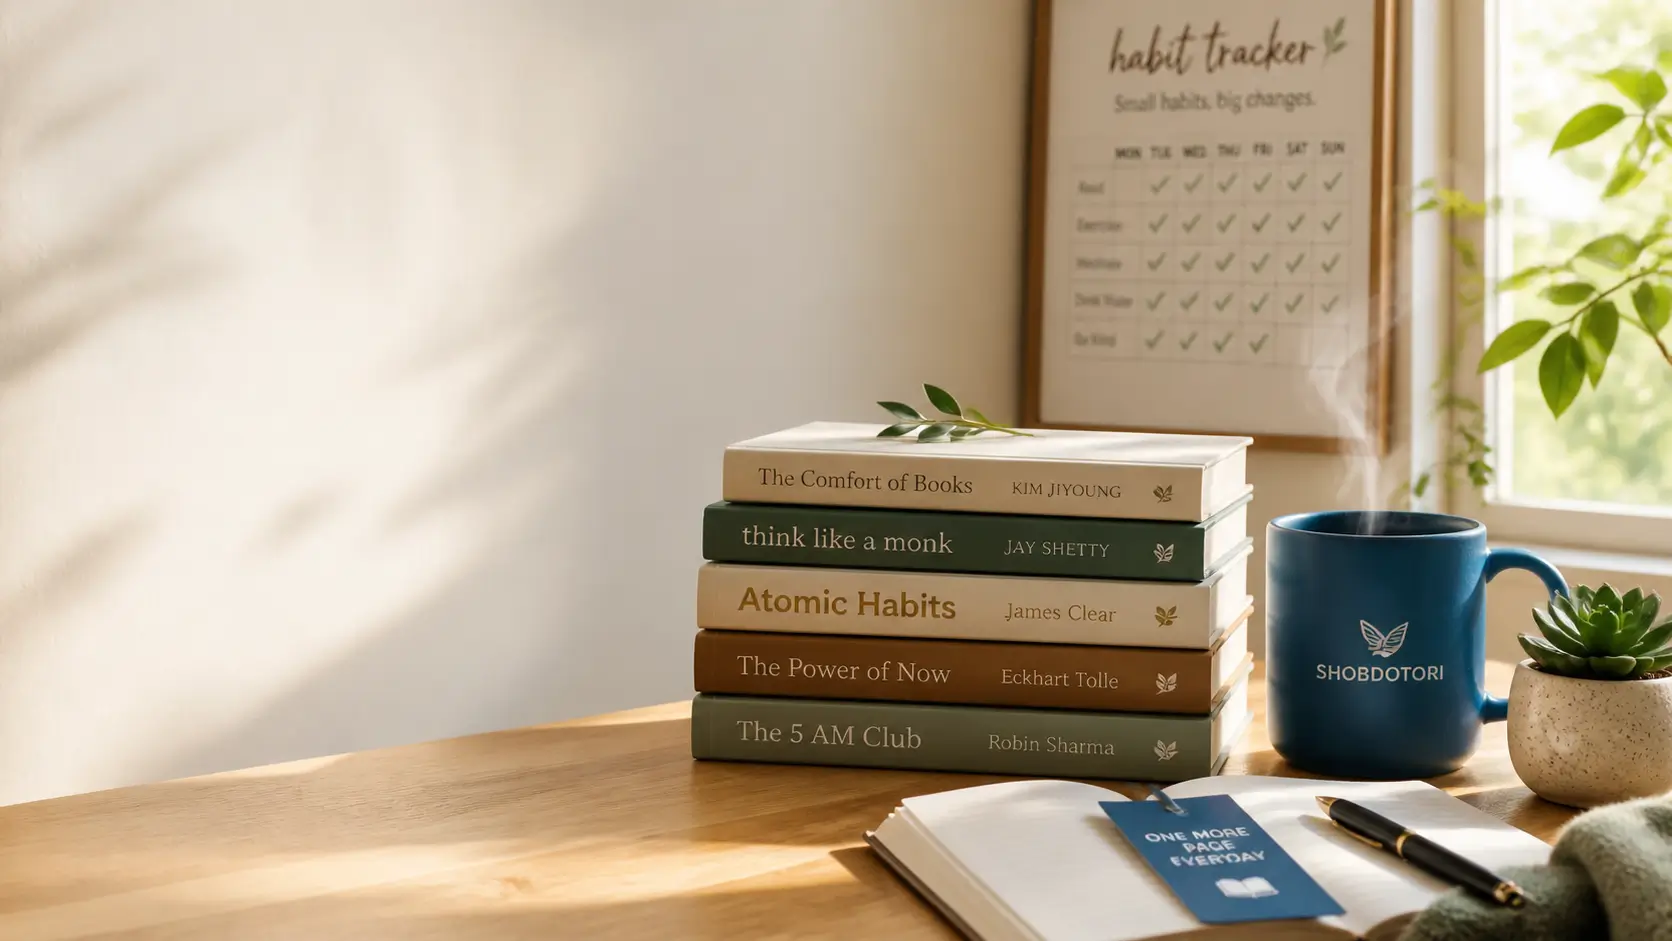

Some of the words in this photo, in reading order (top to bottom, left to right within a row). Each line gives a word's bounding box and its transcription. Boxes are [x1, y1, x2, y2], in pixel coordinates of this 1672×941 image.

[1108, 23, 1197, 75] habit
[1201, 18, 1316, 74] tracker
[1114, 93, 1157, 113] Small
[1216, 91, 1242, 114] big
[1114, 146, 1142, 160] MON
[1149, 145, 1172, 160] TUE
[1182, 145, 1207, 159] WED
[1217, 144, 1241, 158] THU
[1253, 142, 1274, 156] FRI
[1286, 141, 1308, 156] SAT
[1321, 141, 1345, 155] SUN
[758, 468, 796, 488] The
[800, 469, 883, 492] Comfort
[887, 471, 910, 491] of
[914, 473, 974, 495] Books
[1012, 481, 1043, 496] KIM
[1047, 482, 1122, 499] JIYOUNG
[742, 524, 806, 548] think
[813, 527, 857, 550] like
[863, 536, 877, 551] a
[884, 531, 954, 555] monk
[1004, 540, 1036, 557] JAY
[1042, 541, 1110, 558] SHETTY
[738, 586, 848, 617] Atomic
[858, 591, 957, 620] Habits
[1005, 602, 1061, 623] James
[1068, 604, 1117, 623] Clear
[737, 655, 781, 678] The
[788, 657, 858, 681] Power
[867, 660, 892, 682] of
[897, 661, 952, 684] Now
[1001, 669, 1070, 688] Eckhart
[1075, 671, 1119, 690] Tolle
[1316, 663, 1444, 682] SHOBDOTORI
[737, 720, 782, 743] The
[789, 723, 804, 744] 5
[811, 724, 856, 746] AM
[863, 725, 922, 749] Club
[988, 733, 1040, 752] Robin
[1046, 736, 1115, 756] Sharma
[1145, 831, 1188, 843] ONE
[1182, 839, 1237, 853] PAGE
